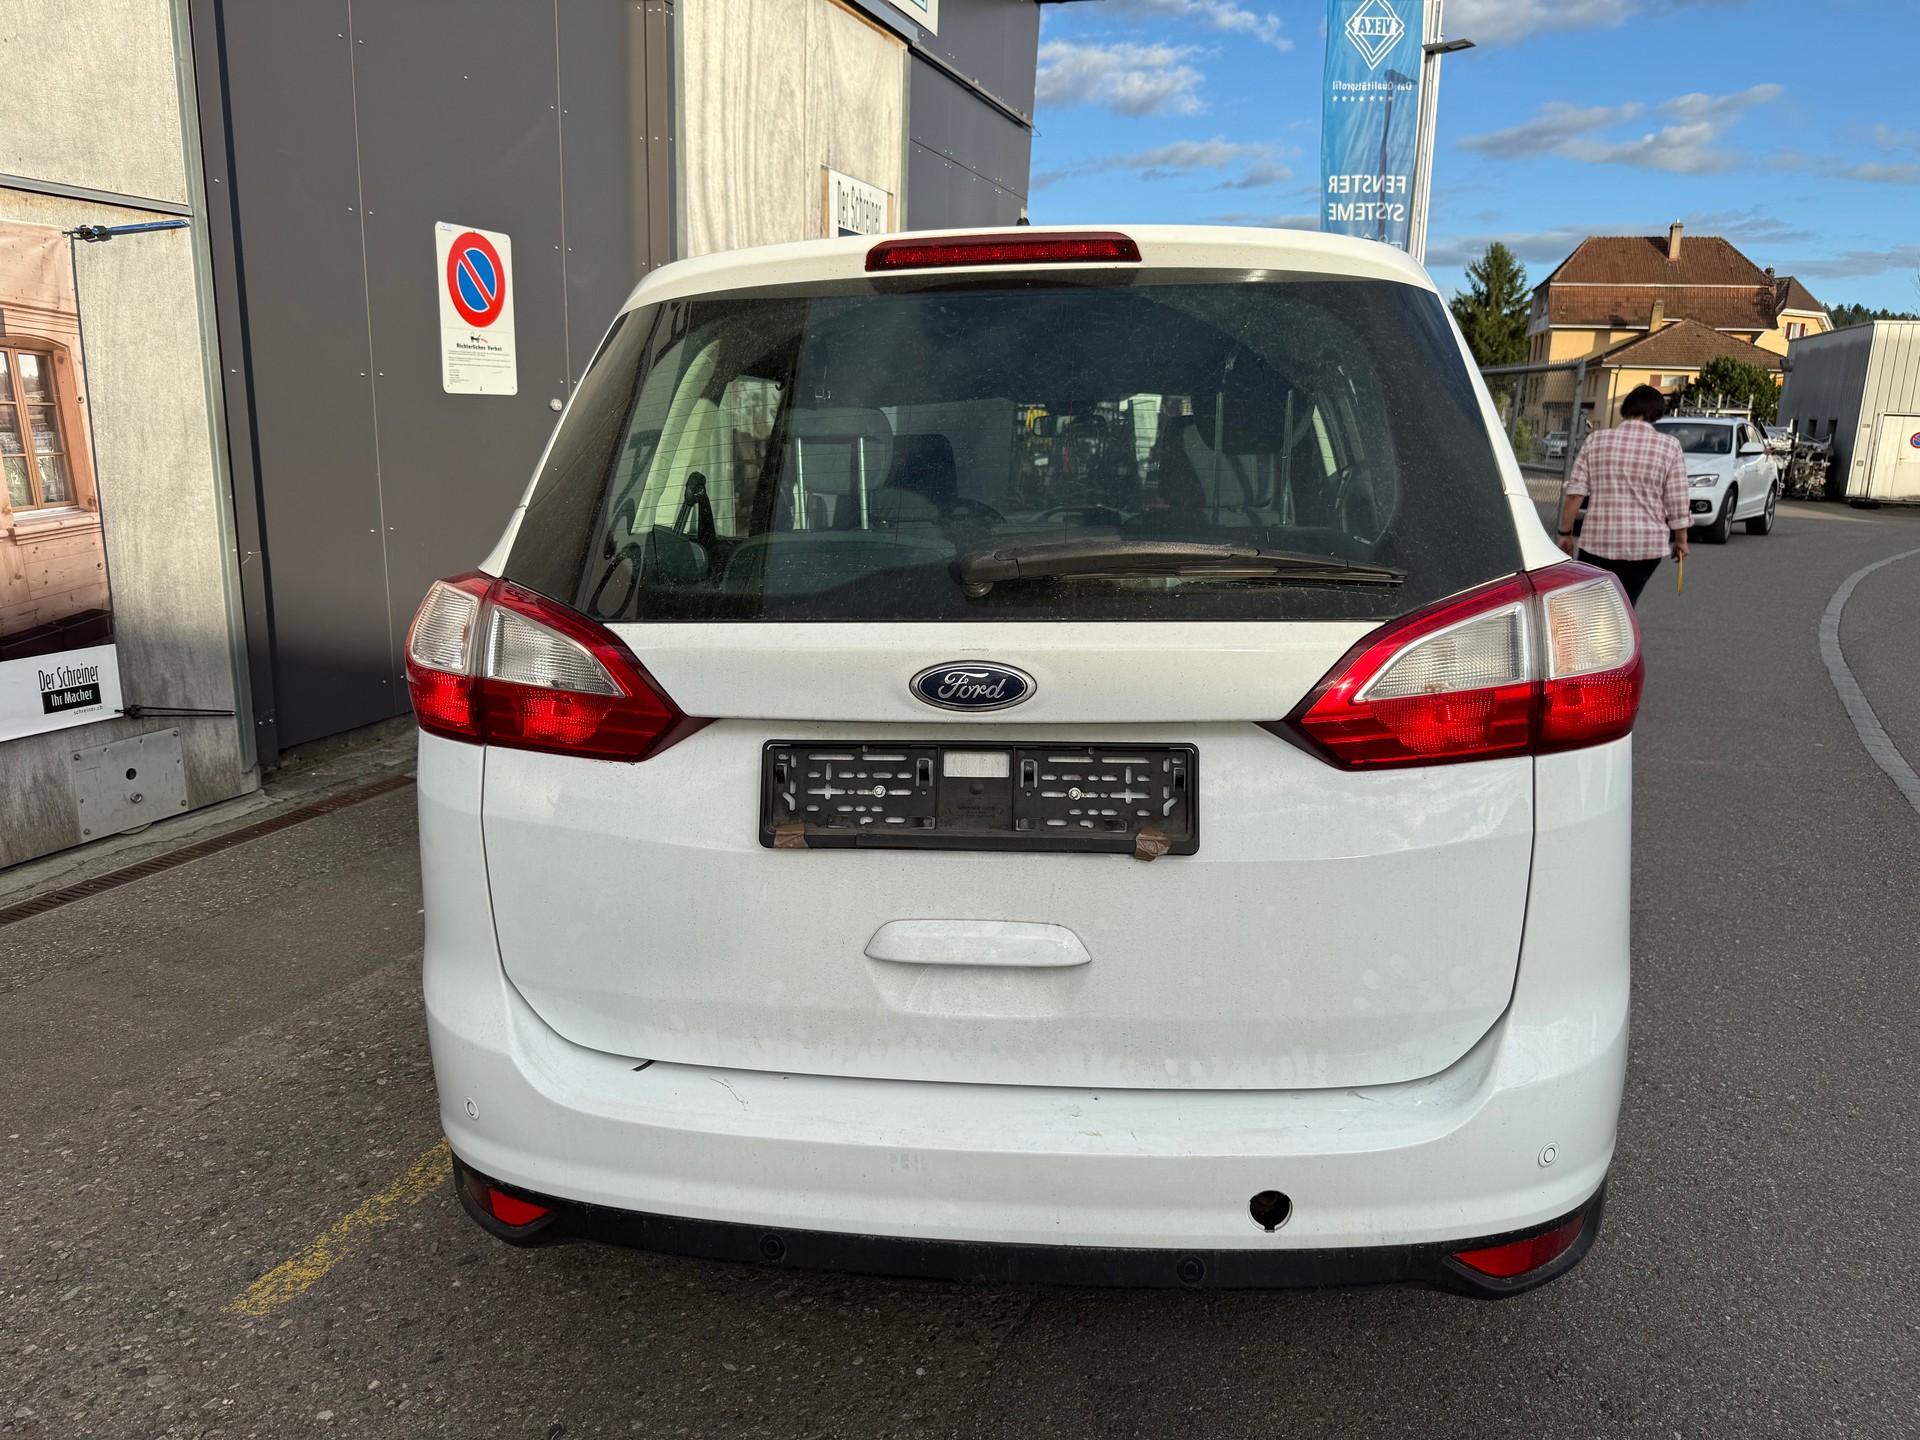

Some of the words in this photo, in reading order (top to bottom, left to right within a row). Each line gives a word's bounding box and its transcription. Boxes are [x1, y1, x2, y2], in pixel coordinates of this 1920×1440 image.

[837, 180, 849, 227] Der
[851, 185, 882, 235] Schreiner
[456, 342, 486, 350] Richterliches
[38, 669, 55, 691] Der
[56, 663, 99, 688] Schreiner
[937, 671, 1007, 699] Ford
[51, 693, 63, 707] Ihr
[64, 689, 93, 705] Macher
[73, 705, 103, 716] schreiner.ch
